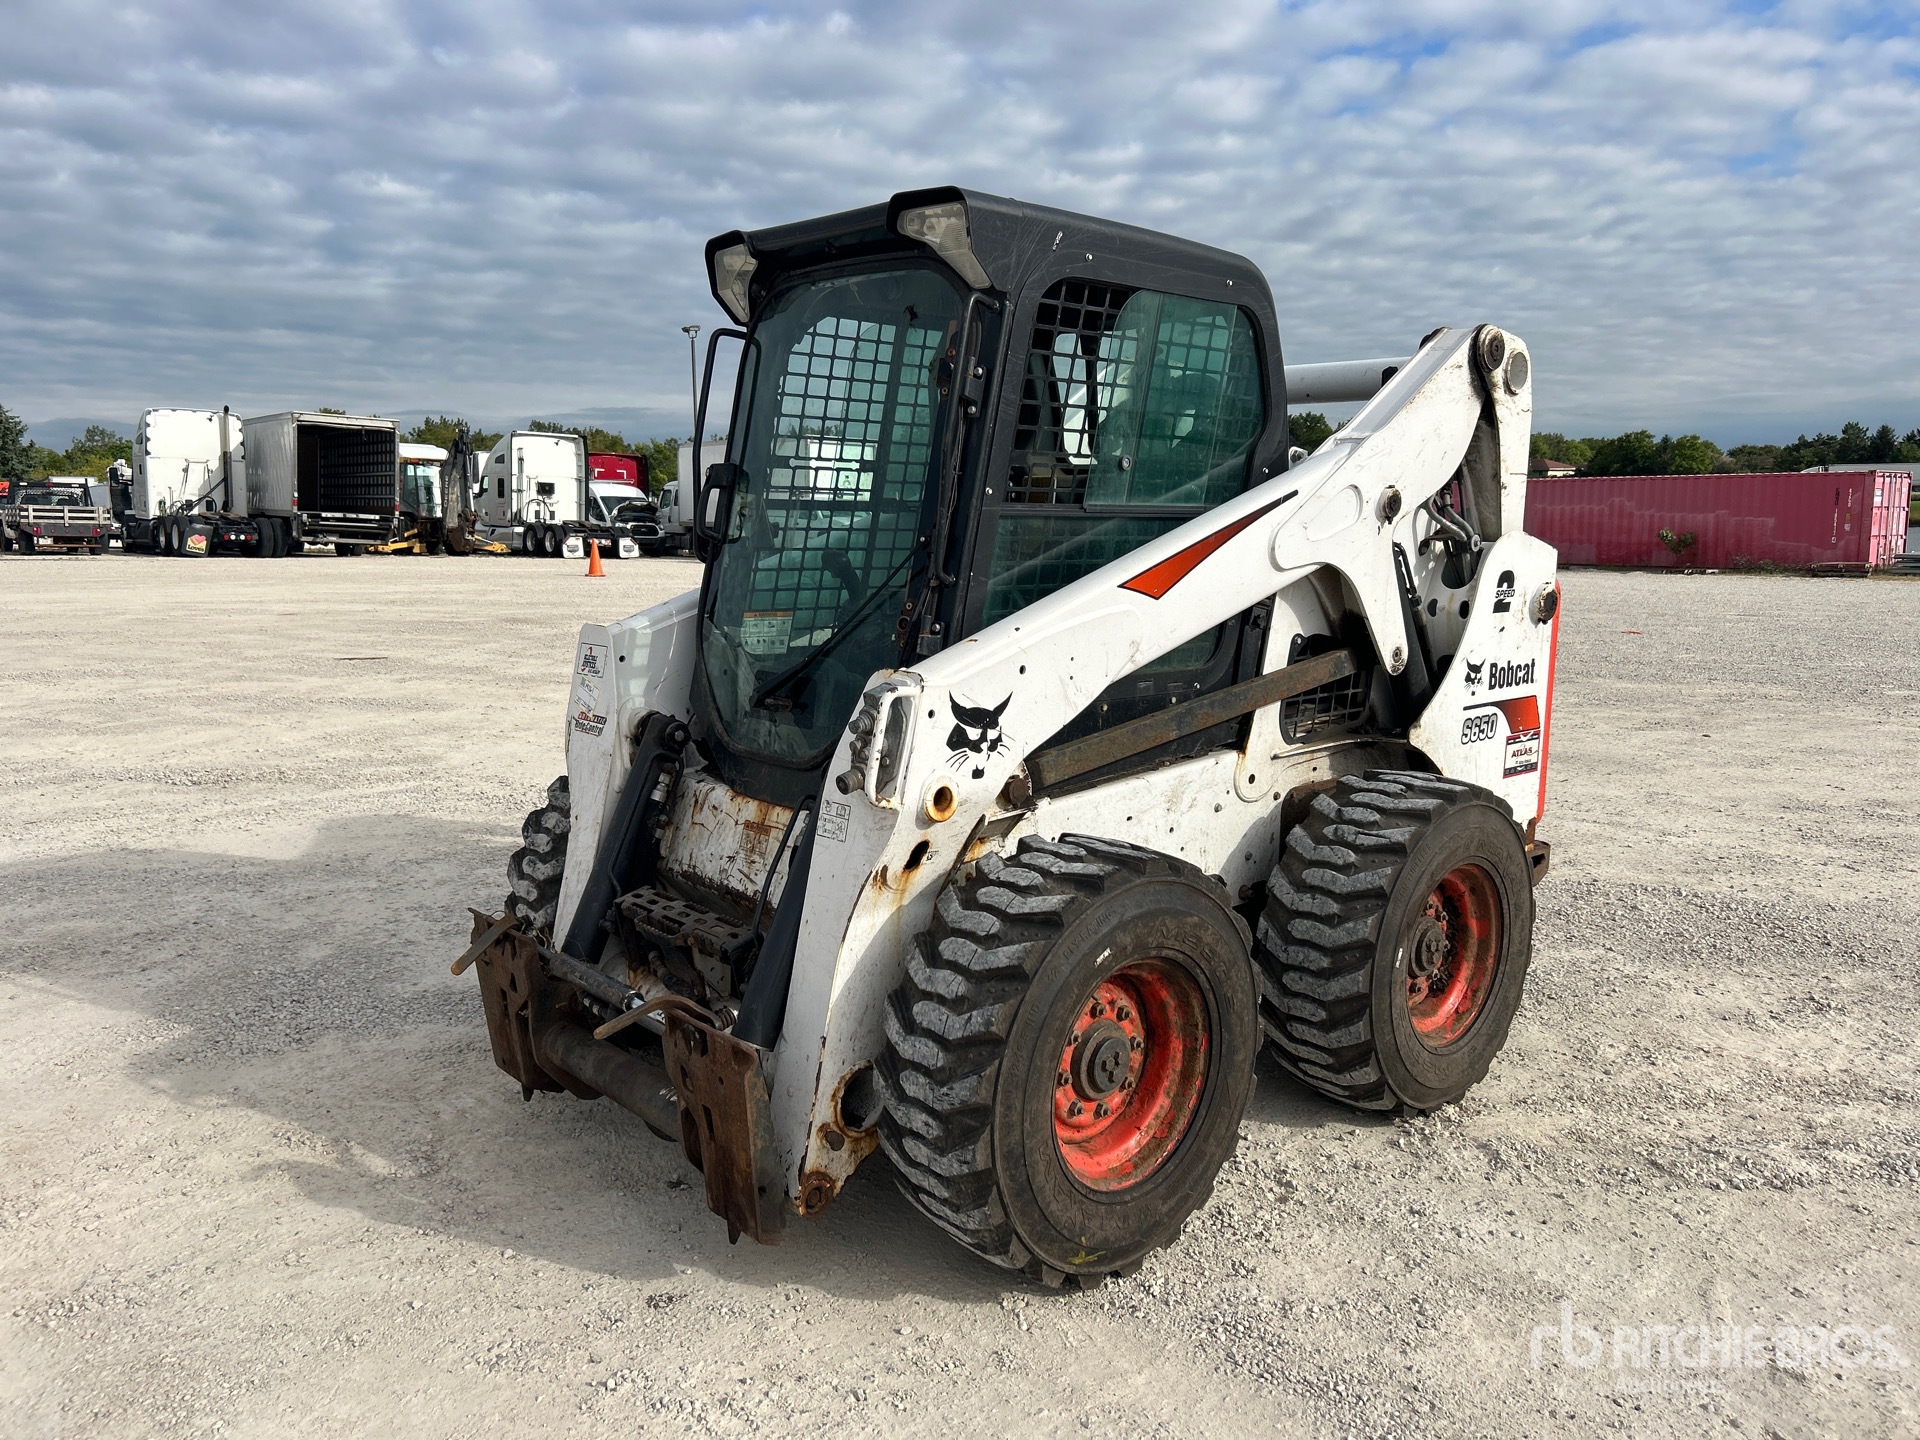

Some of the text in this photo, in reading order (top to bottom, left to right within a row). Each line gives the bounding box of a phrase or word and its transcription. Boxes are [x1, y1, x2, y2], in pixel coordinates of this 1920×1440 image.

[1492, 569, 1515, 613] 2
[1494, 588, 1516, 599] SPEED
[1488, 658, 1536, 690] Bobcat
[1461, 712, 1498, 745] S650
[1511, 747, 1533, 758] ATLAS
